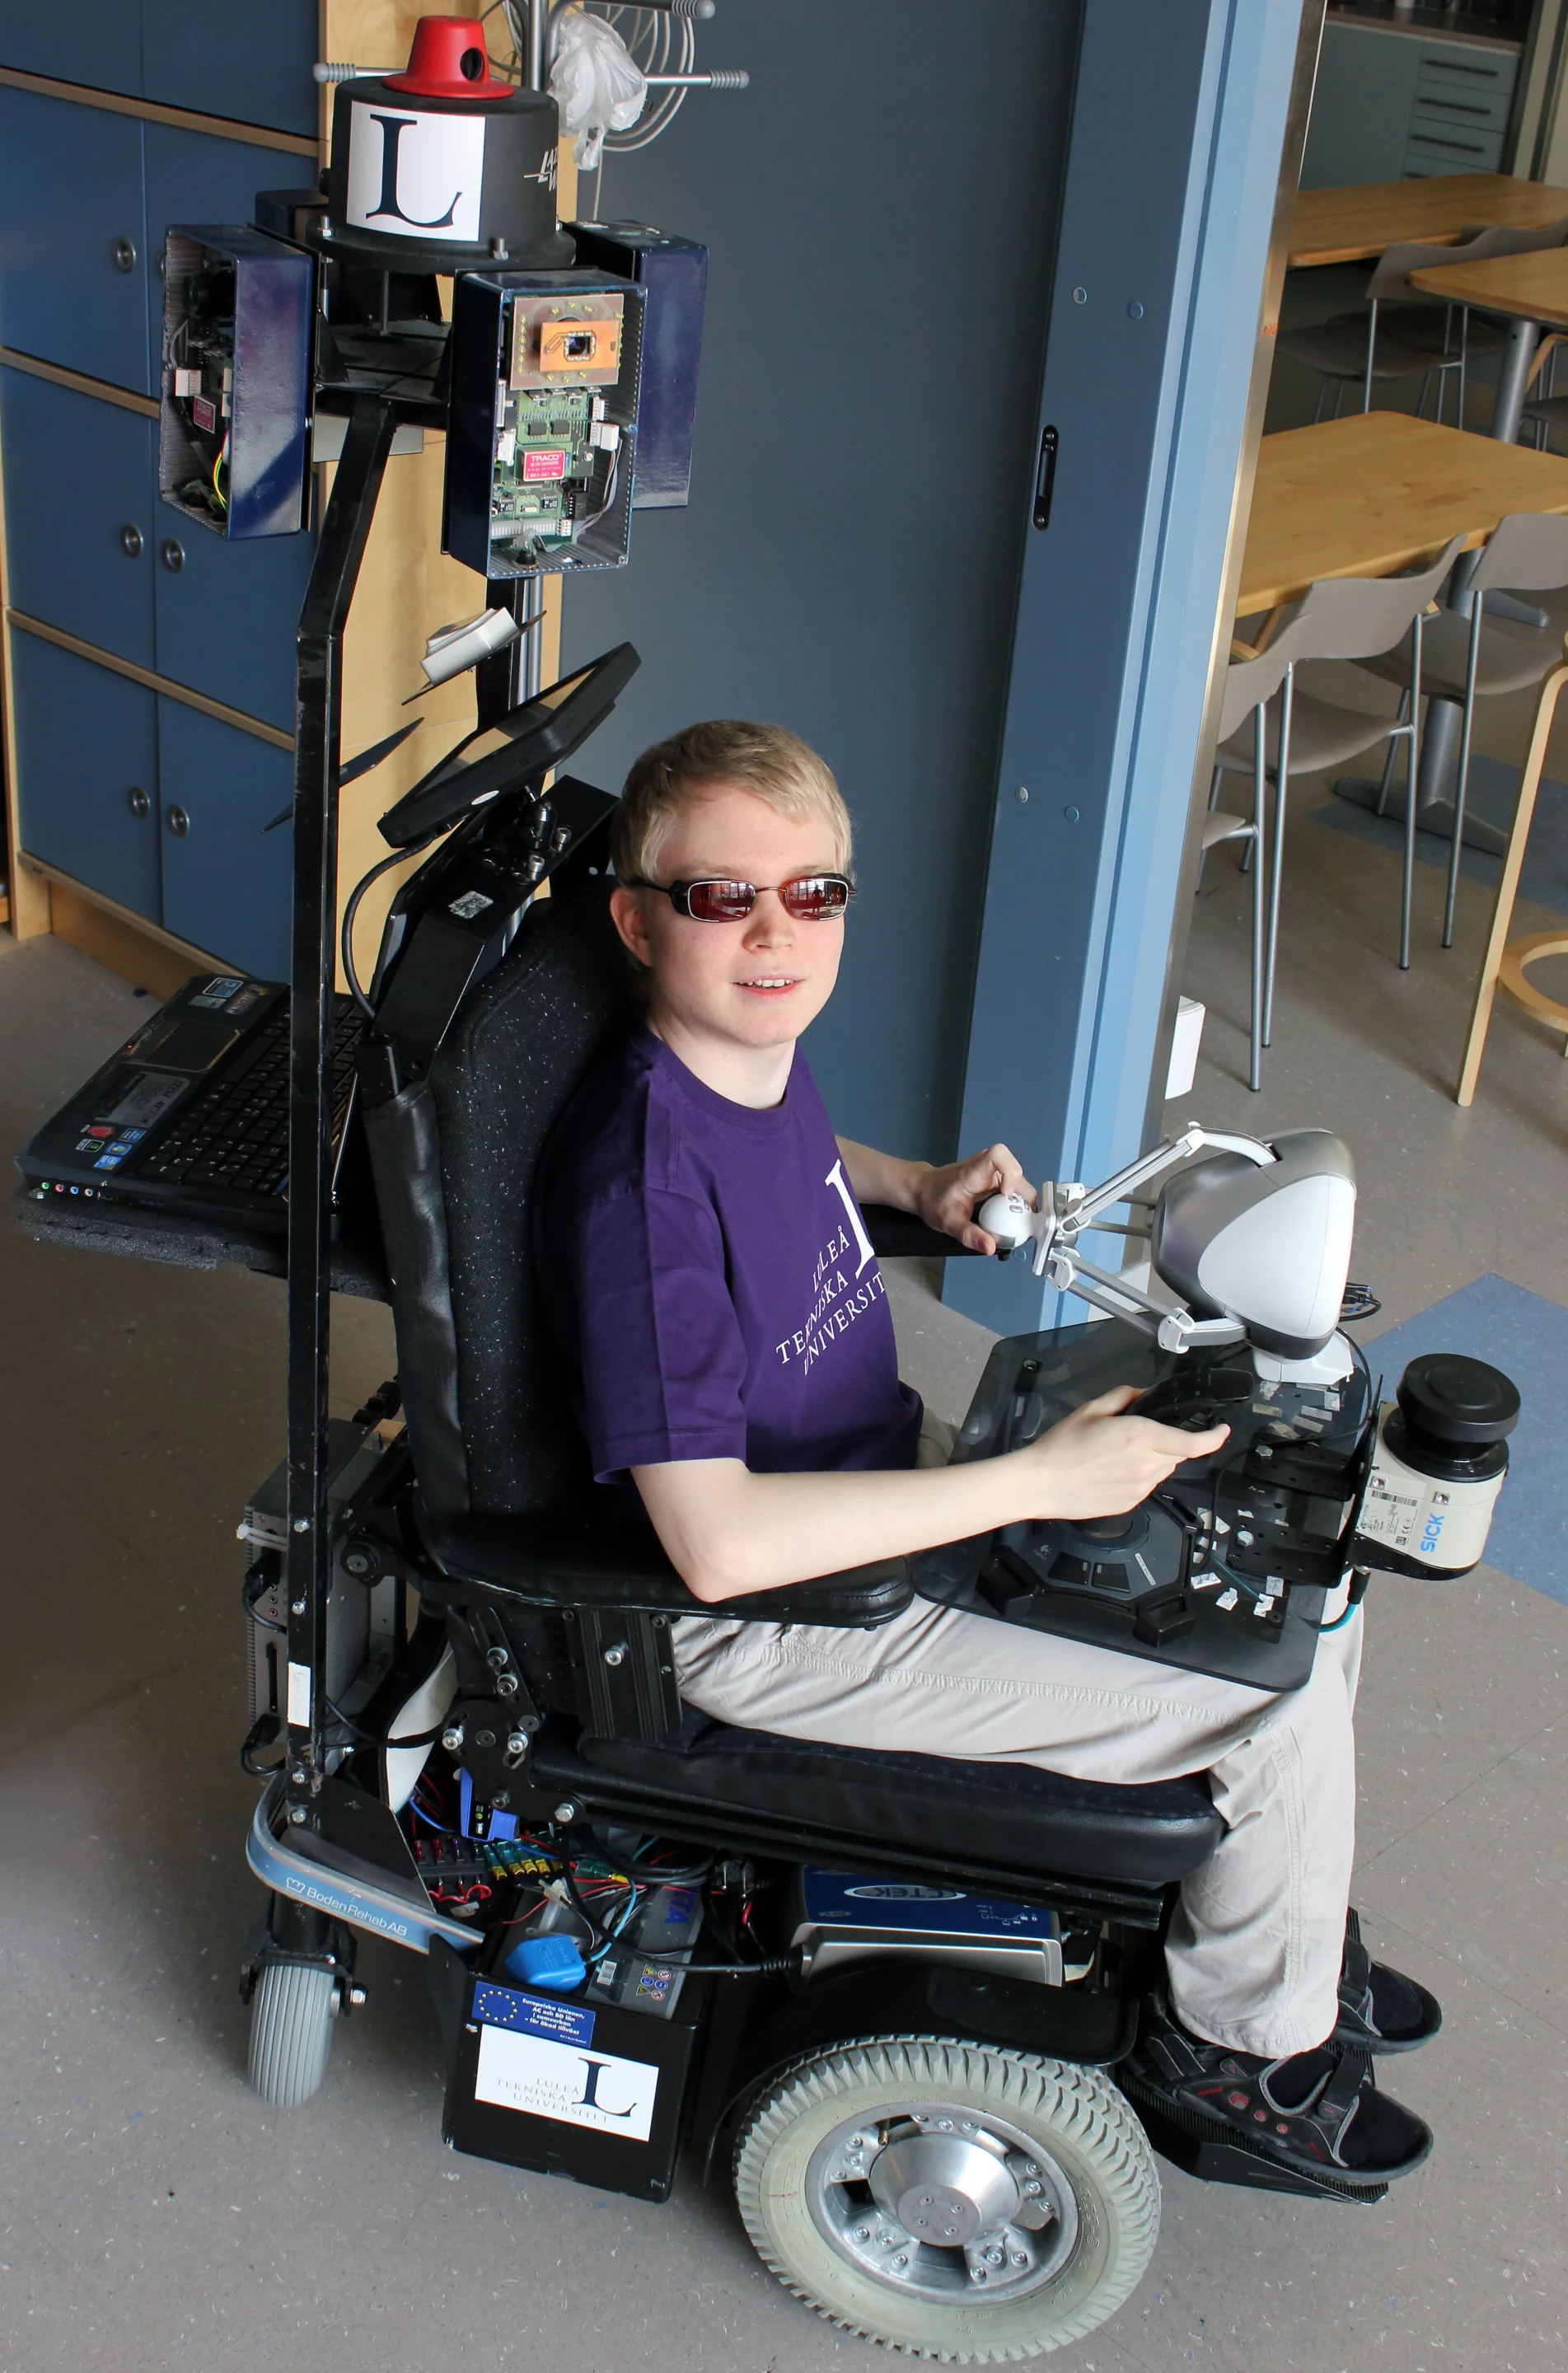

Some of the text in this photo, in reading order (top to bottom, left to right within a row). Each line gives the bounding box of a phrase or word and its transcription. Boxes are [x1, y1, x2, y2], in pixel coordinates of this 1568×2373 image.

[365, 113, 463, 229] L
[812, 1225, 850, 1293] LULEÅ
[775, 1270, 850, 1364] TEKNISKA
[803, 1271, 887, 1376] UNIVERSIT
[1421, 1513, 1445, 1552] SICK
[873, 1887, 944, 1899] CTEK
[522, 1997, 585, 2020] Europeiska Unionen,
[536, 2015, 571, 2027] samverkan
[541, 2019, 556, 2029] ökad
[558, 2024, 579, 2035] tillväxt
[496, 2078, 566, 2102] TEKNISKA
[536, 2078, 579, 2095] LULEÅ
[571, 2057, 638, 2118] L
[513, 2092, 610, 2123] UNIVERSITET
